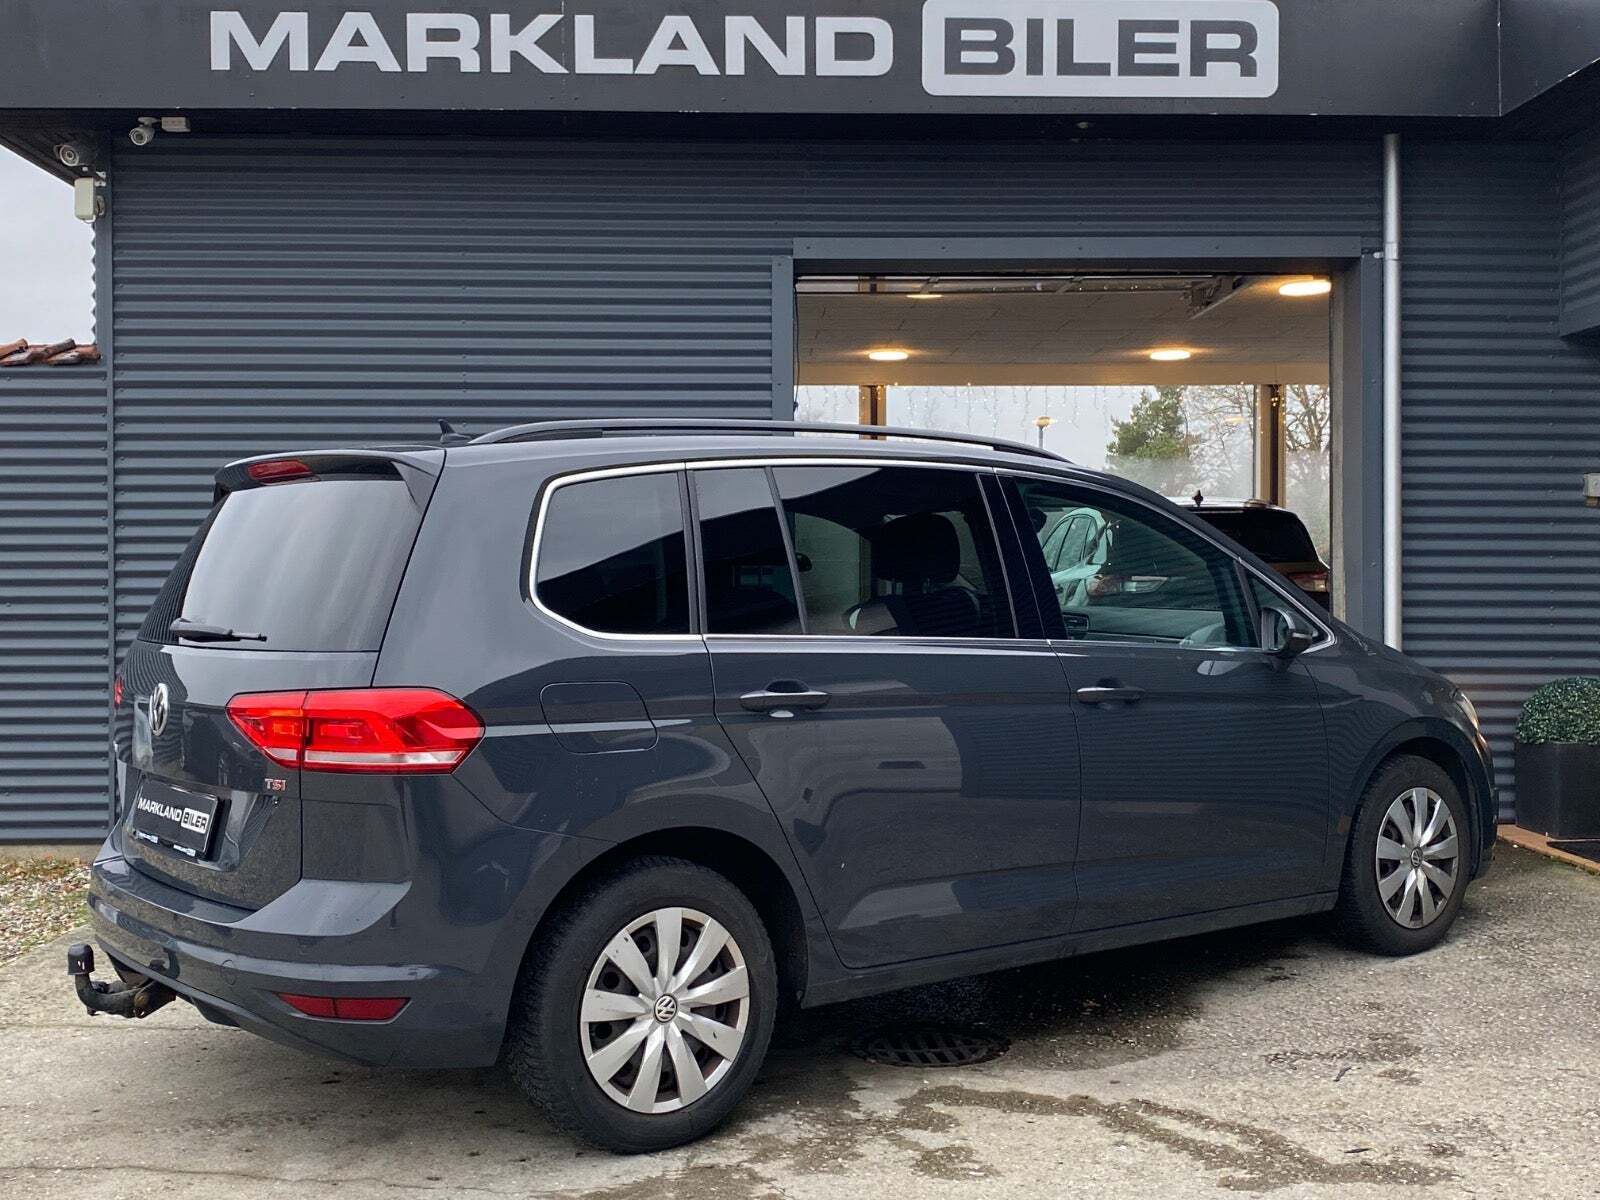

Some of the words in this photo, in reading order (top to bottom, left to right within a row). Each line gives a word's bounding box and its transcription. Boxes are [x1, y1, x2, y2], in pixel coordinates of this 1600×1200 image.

[210, 11, 894, 76] MARKLAND
[945, 18, 1257, 77] BILER
[264, 778, 287, 791] TSI
[138, 797, 182, 821] MARKLAND
[183, 811, 208, 830] BILER
